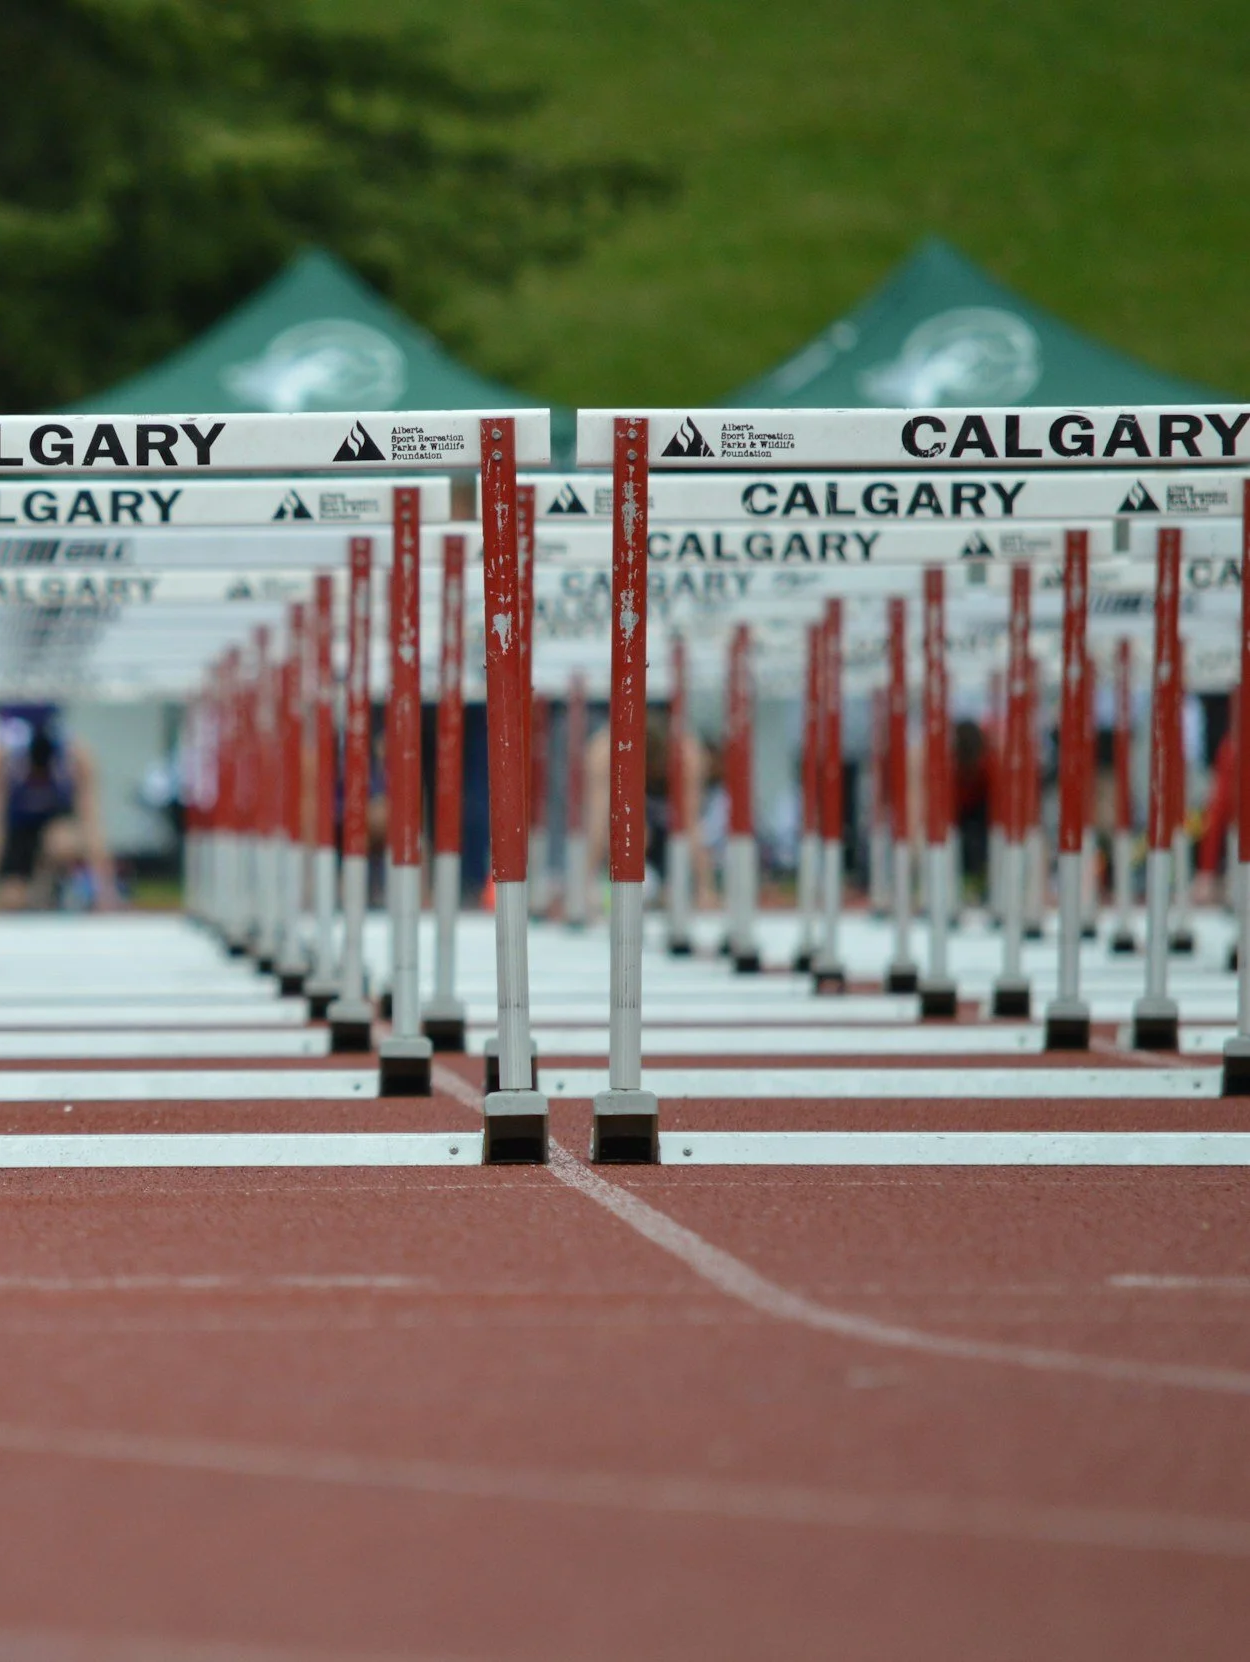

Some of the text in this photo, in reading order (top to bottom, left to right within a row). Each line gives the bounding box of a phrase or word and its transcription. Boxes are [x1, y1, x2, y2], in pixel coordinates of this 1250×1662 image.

[721, 423, 754, 431] Alberta
[391, 434, 465, 444] Sport Recreation
[721, 432, 794, 440] Sport Recreation
[902, 413, 1250, 458] CALGARY
[430, 443, 465, 451] Wildlife
[721, 440, 795, 449] Parks & Wildlife
[391, 452, 442, 460] Foundation
[721, 450, 772, 458] Foundation
[741, 481, 1027, 517] CALGARY
[647, 532, 879, 562] CALGARY
